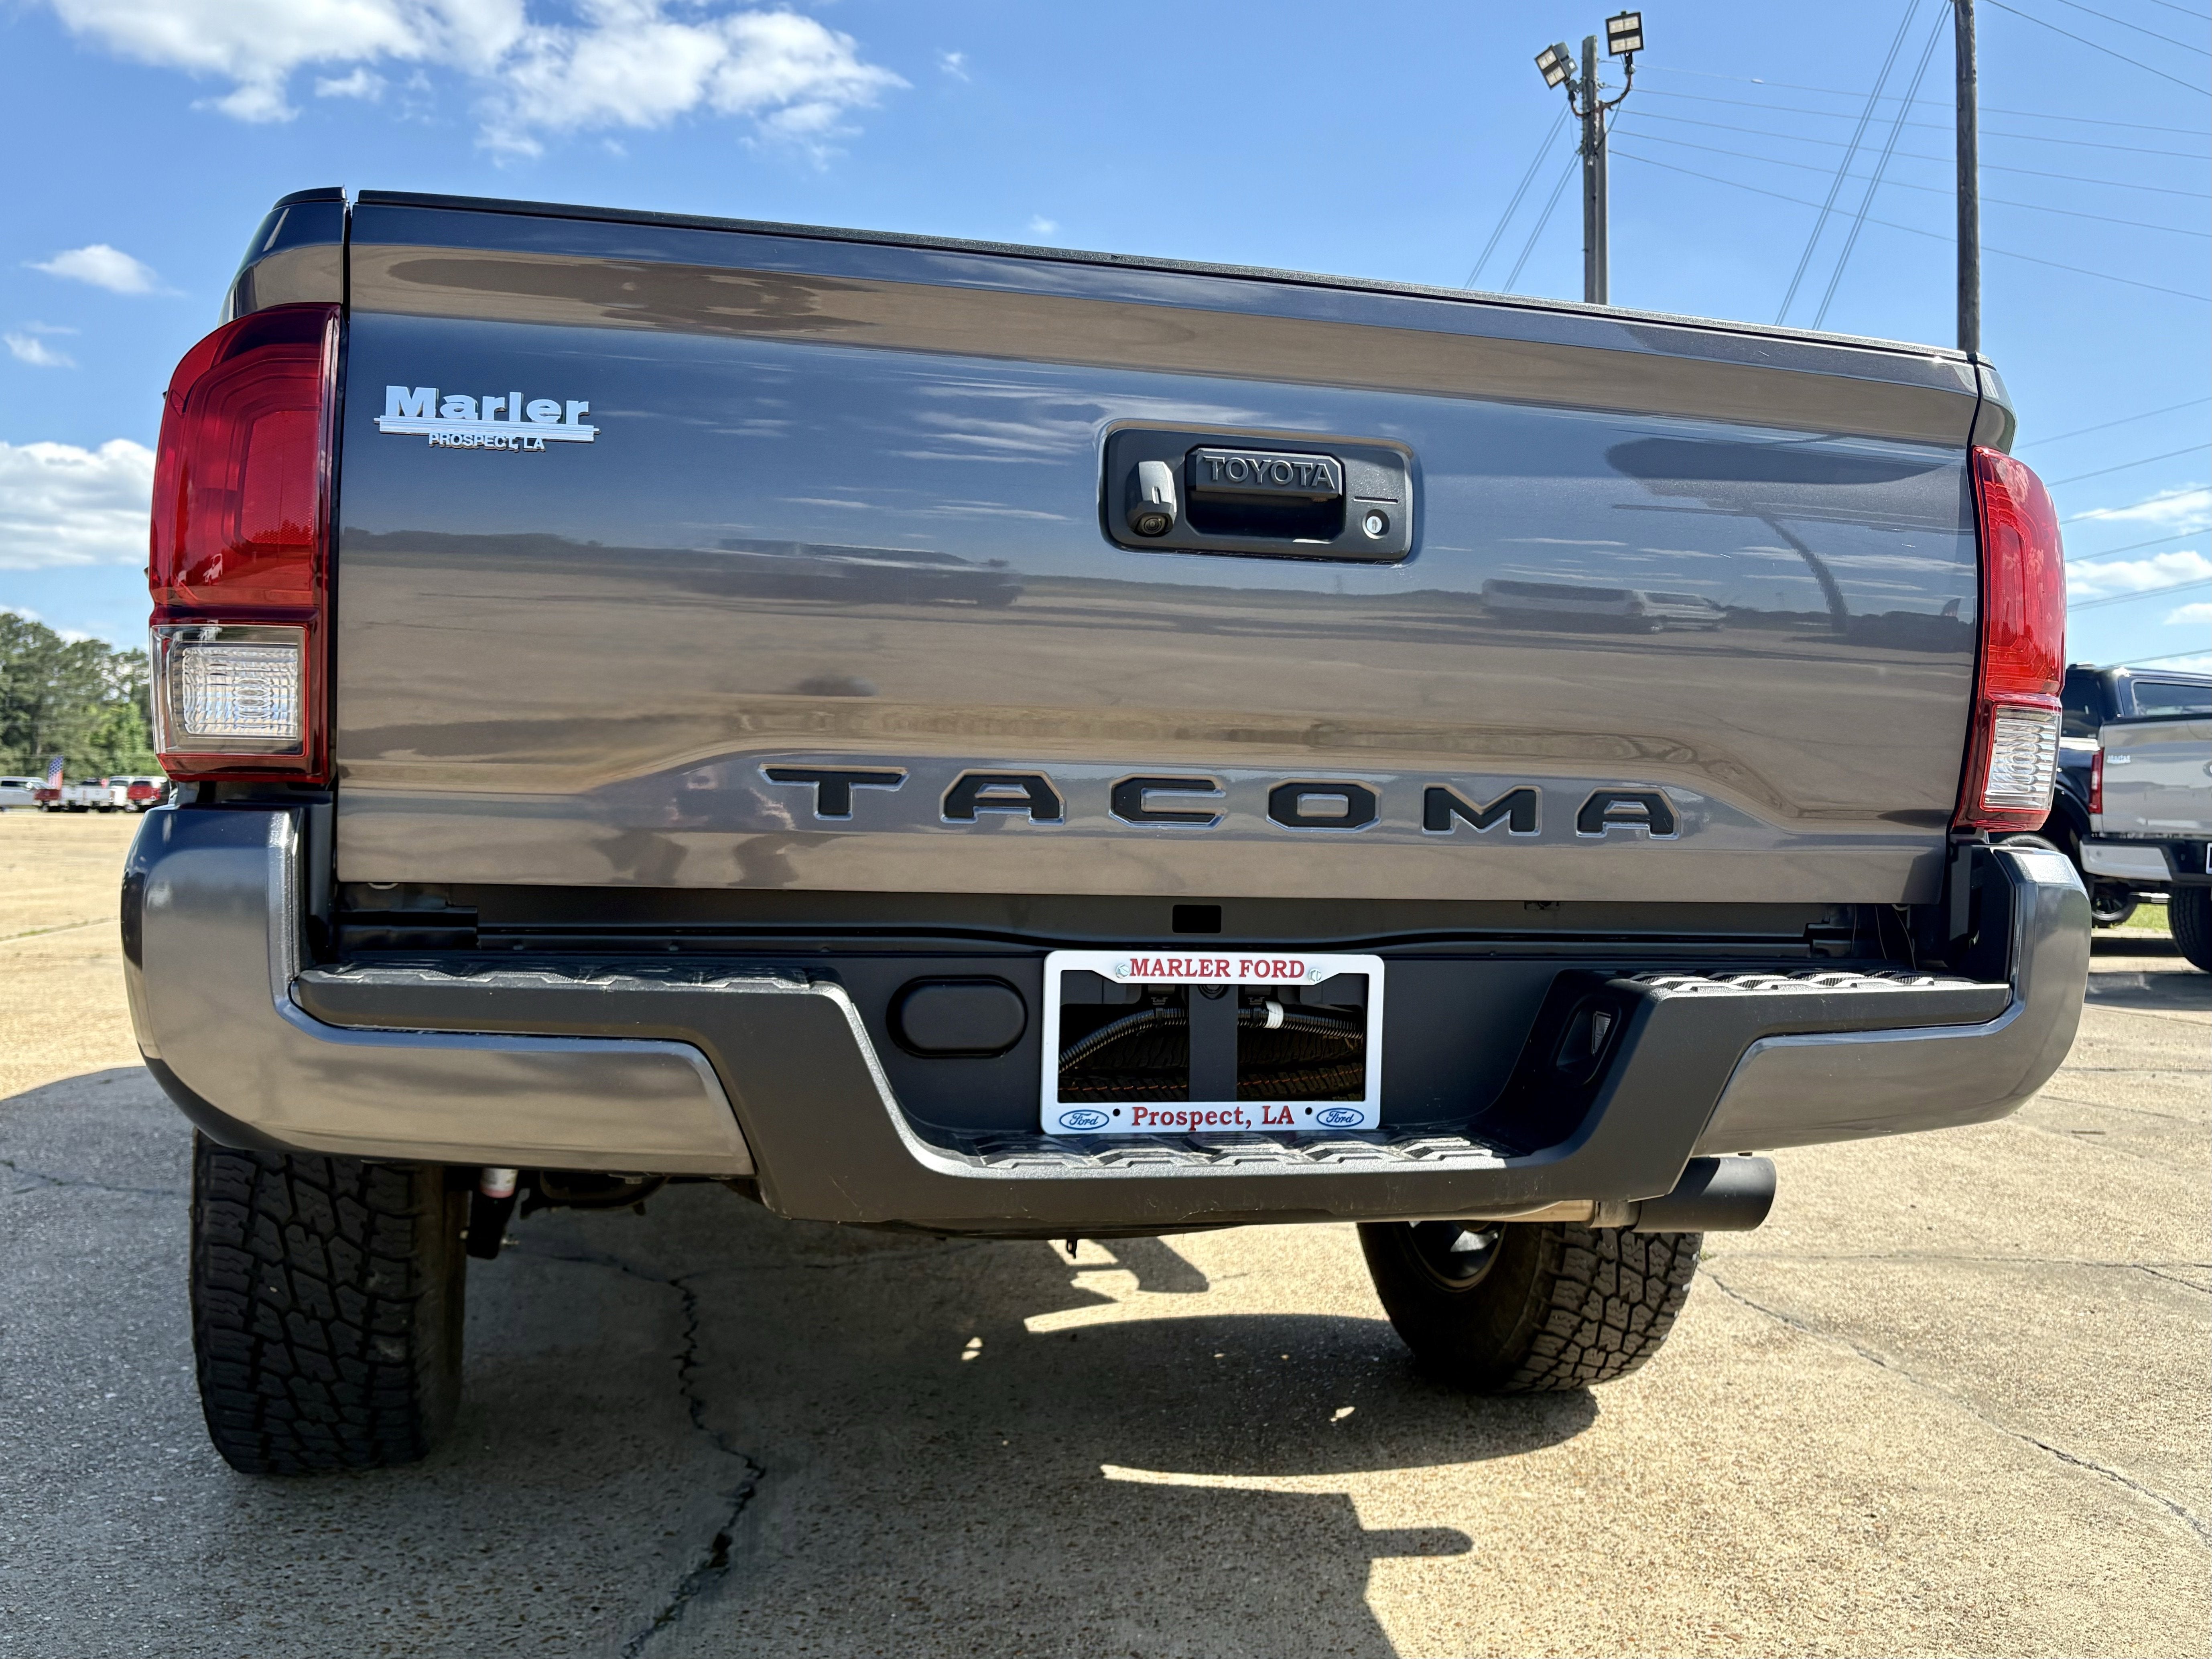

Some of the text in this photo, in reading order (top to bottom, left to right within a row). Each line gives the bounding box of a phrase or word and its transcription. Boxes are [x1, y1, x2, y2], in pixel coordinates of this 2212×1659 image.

[385, 385, 590, 424] Marler
[523, 436, 545, 450] LA
[1204, 455, 1335, 490] TOYOTA
[758, 763, 1681, 839] TACOMA
[1129, 958, 1305, 979] MARLER FORD
[1069, 1113, 1099, 1126] Ford
[1131, 1105, 1295, 1131] Prospect, LA
[1326, 1110, 1355, 1123] Ford
